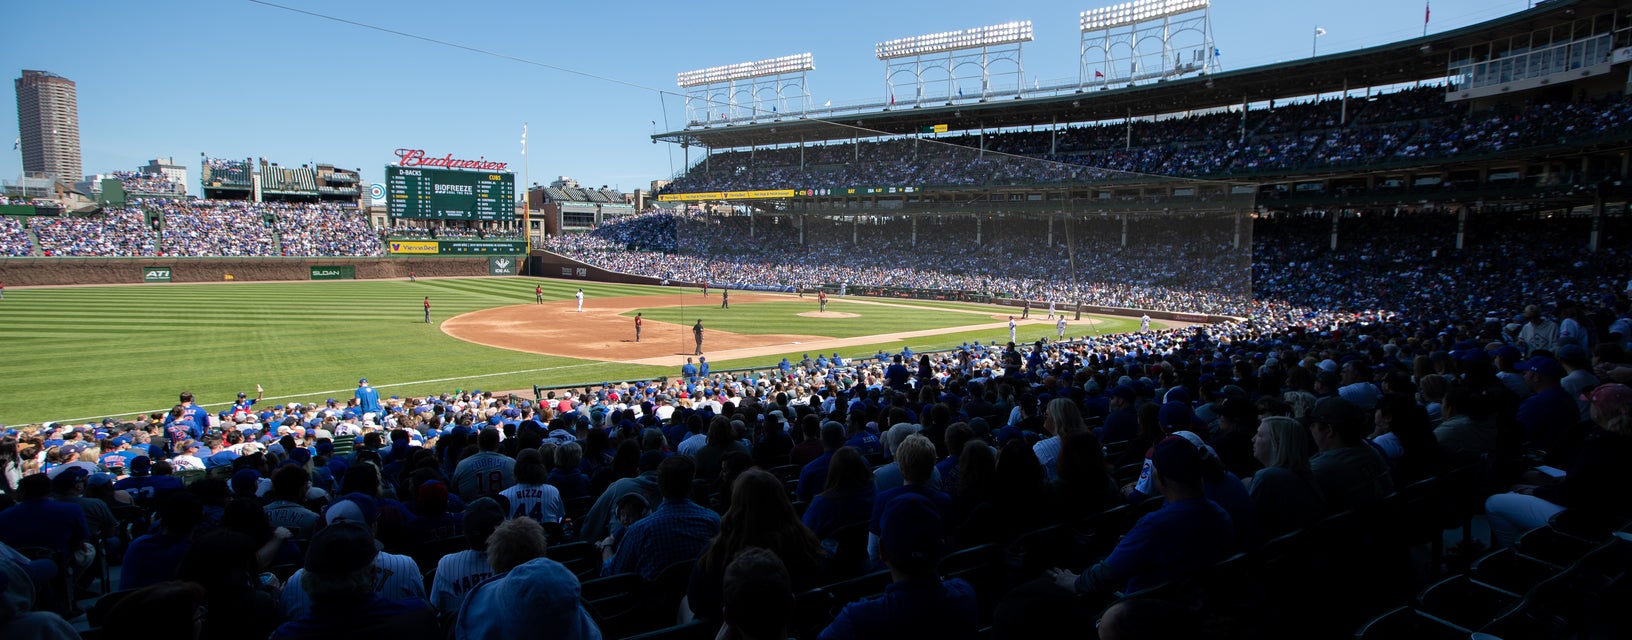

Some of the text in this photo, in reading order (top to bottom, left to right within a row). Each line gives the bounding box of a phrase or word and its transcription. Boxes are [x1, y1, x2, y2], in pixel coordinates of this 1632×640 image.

[395, 148, 507, 170] Budweiser
[475, 470, 503, 494] 18
[516, 488, 542, 499] RIZZO
[266, 509, 304, 522] RYANT
[513, 502, 543, 521] 44
